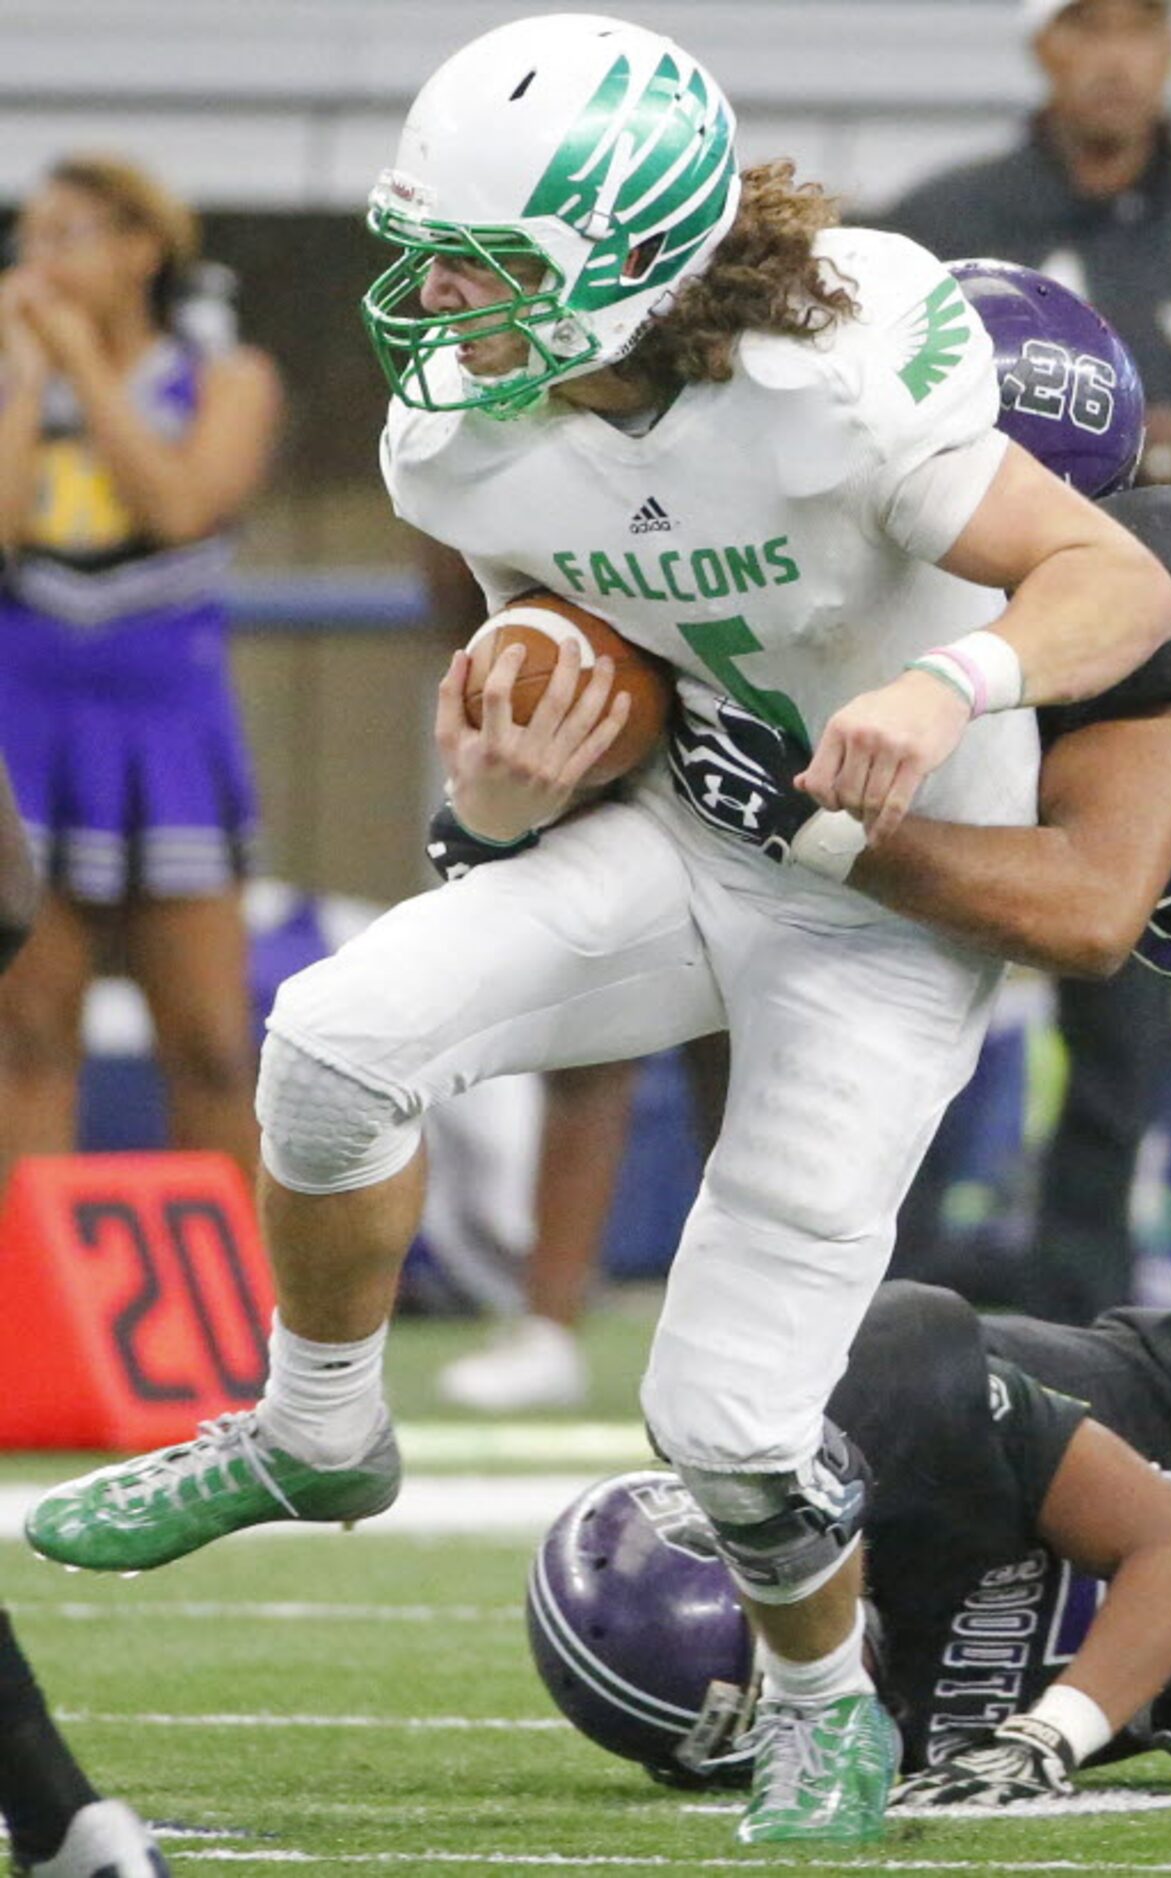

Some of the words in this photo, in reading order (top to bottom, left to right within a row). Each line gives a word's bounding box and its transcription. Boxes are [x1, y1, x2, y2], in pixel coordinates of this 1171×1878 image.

[1000, 338, 1118, 435] 26
[553, 535, 801, 602] FALCONS
[73, 1201, 272, 1403] 20
